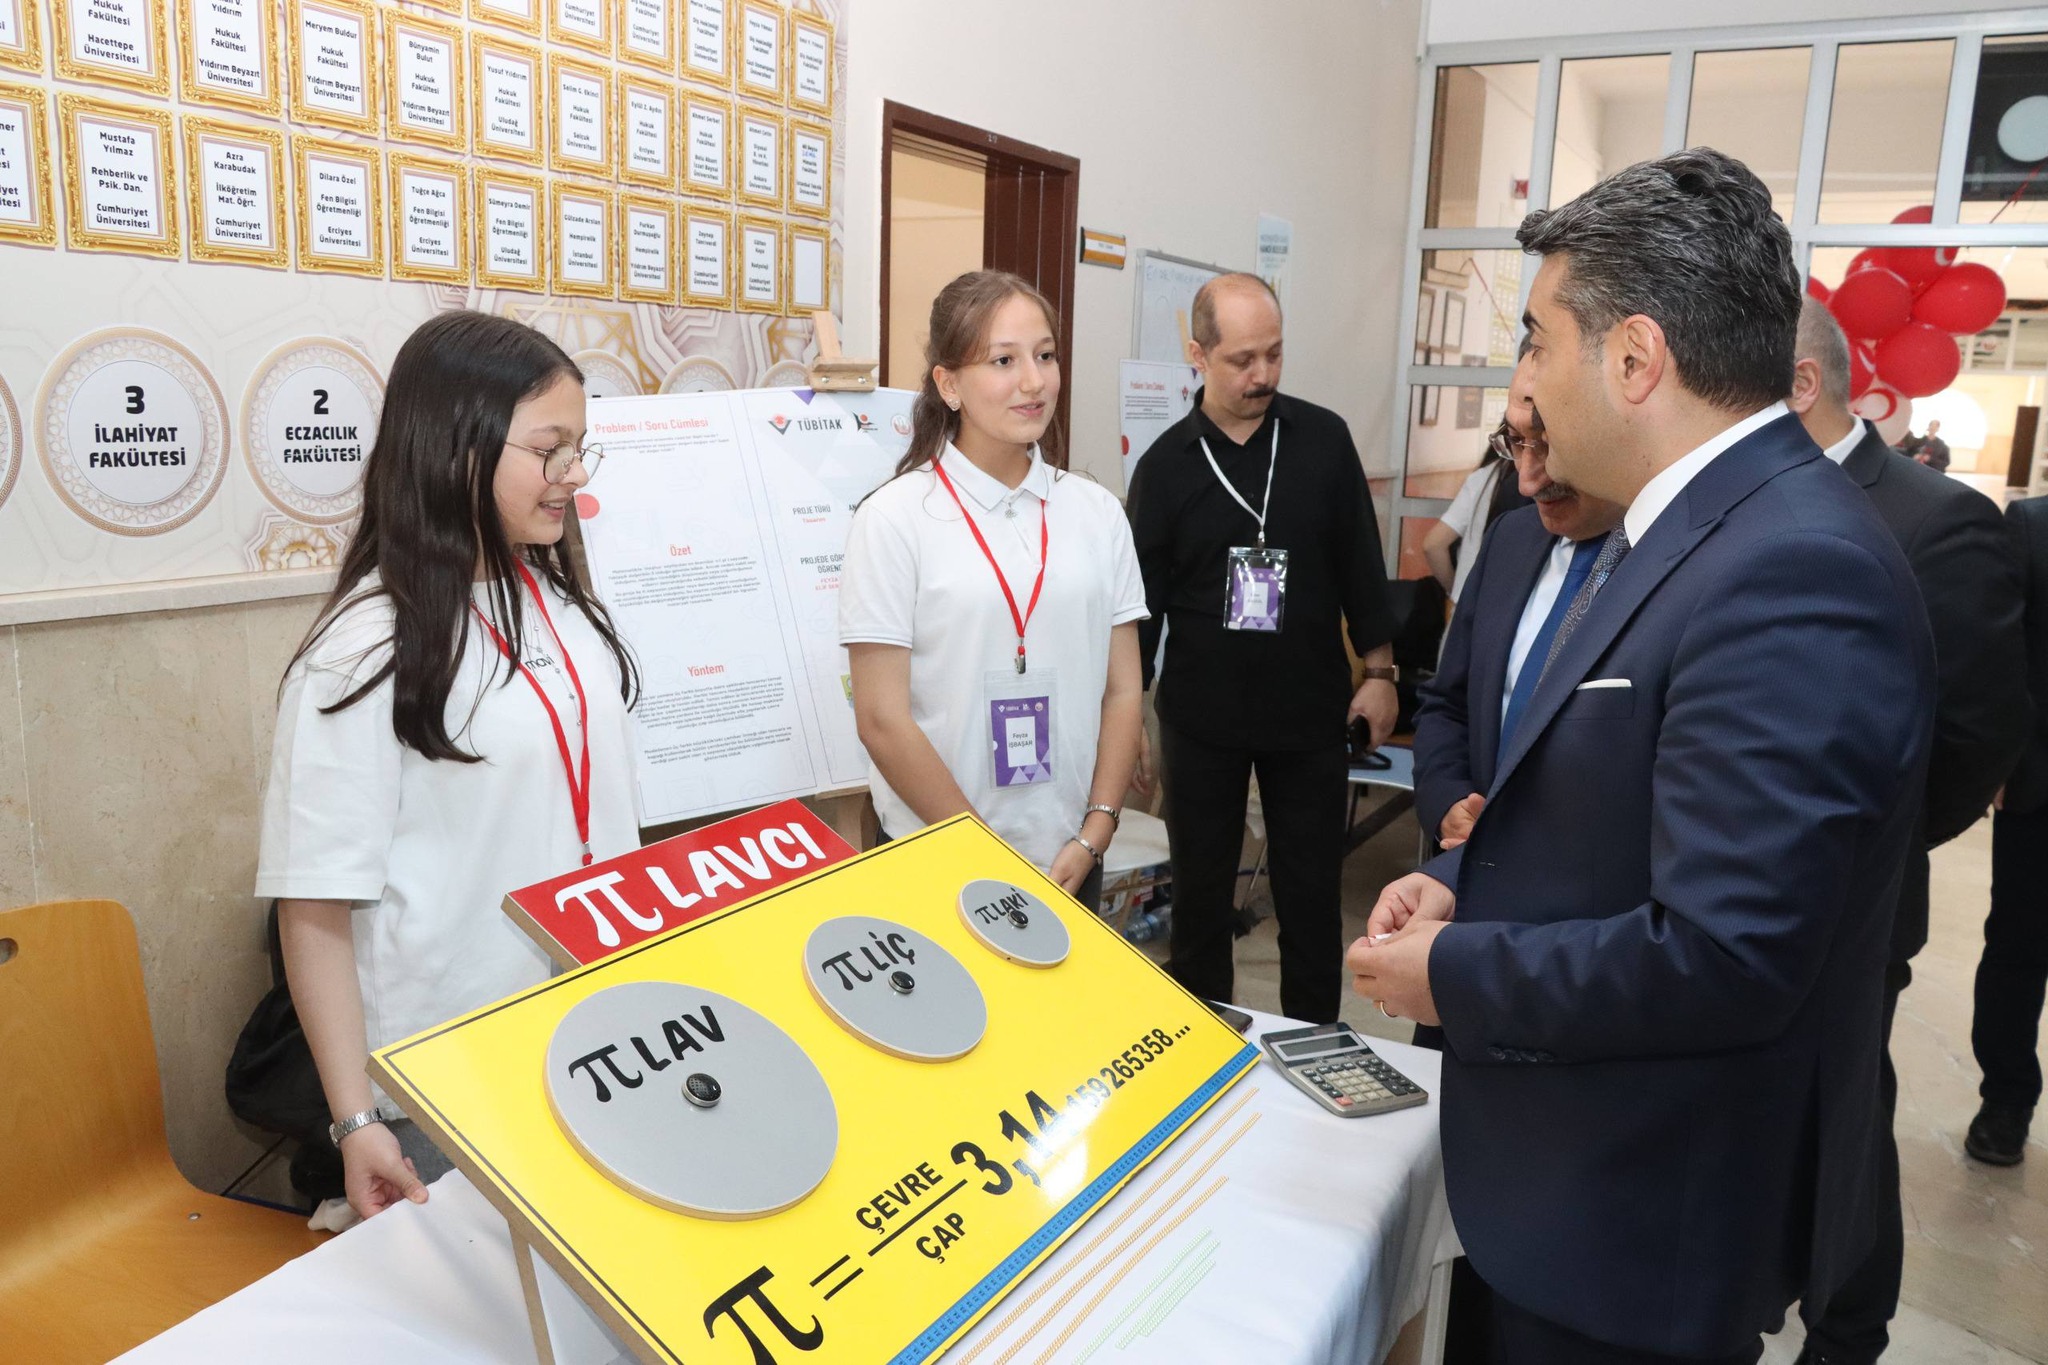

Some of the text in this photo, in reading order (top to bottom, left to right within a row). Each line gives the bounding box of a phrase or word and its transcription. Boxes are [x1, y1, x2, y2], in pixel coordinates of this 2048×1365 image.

[94, 0, 123, 12] Hukuk
[212, 4, 242, 17] Yıldırım
[88, 9, 130, 25] Fakültesi
[216, 28, 240, 39] Hukuk
[306, 21, 356, 38] Meryem Buldur
[88, 34, 133, 50] Hacettepe
[212, 38, 246, 52] Fakültesi
[409, 41, 439, 54] Bünyamin
[84, 46, 139, 63] Üniversitesi
[321, 46, 343, 57] Hukuk
[417, 53, 432, 62] Bulut
[199, 59, 259, 77] Yıldırım Beyazıt
[318, 56, 348, 68] Fakültesi
[488, 66, 503, 74] Yusuf
[208, 72, 253, 87] Üniversitesi
[307, 75, 360, 92] Yıldırım Beyazıt
[415, 74, 434, 82] Hukuk
[314, 86, 354, 101] Üniversitesi
[412, 83, 439, 94] Fakültesi
[402, 101, 449, 116] Yıldırım Beyazıt
[408, 111, 444, 124] Üniversitesi
[100, 132, 135, 144] Mustafa
[104, 145, 133, 156] Yılmaz
[226, 152, 243, 161] Azra
[92, 167, 135, 179] Rehberlik
[214, 161, 256, 174] Karabudak
[320, 173, 356, 184] Dilara Özel
[99, 180, 142, 192] Psik. Dan.
[216, 183, 256, 196] İlköğretim
[412, 186, 445, 198] Tuğçe Ağca
[219, 196, 255, 207] Mat. Öğrt.
[321, 194, 356, 206] Fen Bilgisi
[97, 204, 147, 217] Cumhuriyet
[317, 203, 361, 217] Öğretmenliği
[426, 208, 445, 217] Bilgisi
[97, 214, 149, 228] Üniversitesi
[216, 218, 260, 230] Cumhuriyet
[410, 215, 449, 228] Öğretmenliği
[216, 227, 262, 240] Üniversitesi
[328, 226, 352, 236] Erciyes
[320, 234, 360, 246] Üniversitesi
[419, 237, 440, 246] Erciyes
[412, 246, 448, 255] Üniversitesi
[125, 386, 144, 414] 3
[313, 389, 329, 414] 2
[595, 421, 636, 434] Problem
[645, 420, 668, 431] Soru
[671, 418, 709, 429] Cümlesi
[798, 417, 843, 431] TÜBİTAK
[95, 423, 178, 442] İLAHİYAT
[285, 426, 357, 441] ECZACILIK
[89, 447, 186, 468] FAKÜLTESİ
[283, 445, 361, 463] FAKÜLTESİ
[793, 505, 831, 515] PROJE TÜRÜ
[670, 545, 691, 556] Özet
[800, 554, 845, 564] PROJEDE GÖR
[688, 663, 724, 677] Yöntem
[645, 822, 826, 908] LAVCI
[990, 887, 1029, 916] LAKİ
[860, 930, 917, 970] LİÇ
[630, 1005, 726, 1072] LAV
[856, 1161, 944, 1234] ÇEVRE
[916, 1212, 966, 1264] ÇAP
